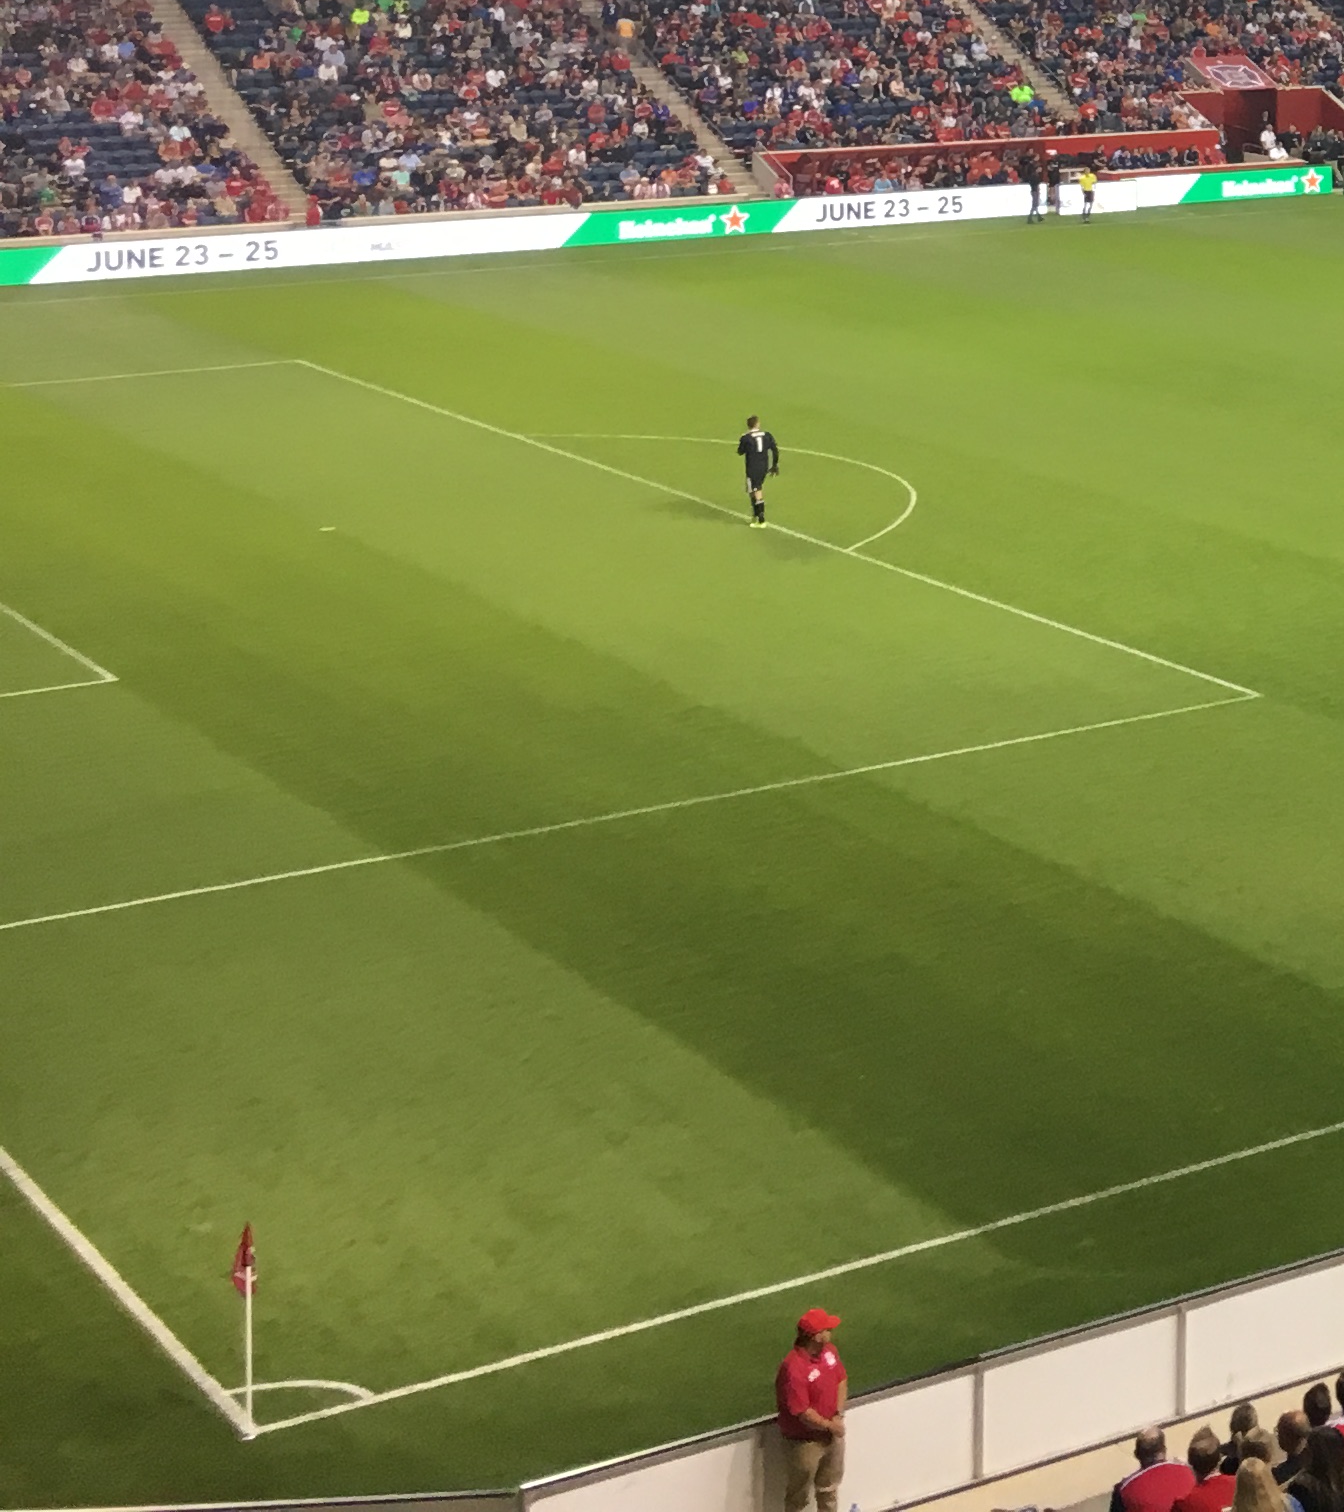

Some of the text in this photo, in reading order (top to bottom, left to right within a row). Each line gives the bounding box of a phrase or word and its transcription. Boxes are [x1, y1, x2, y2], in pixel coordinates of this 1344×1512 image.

[816, 201, 876, 223] JUNE
[883, 199, 910, 218] 23
[938, 196, 963, 215] 25
[86, 248, 164, 272] JUNE
[175, 245, 209, 266] 23
[245, 240, 279, 262] 25
